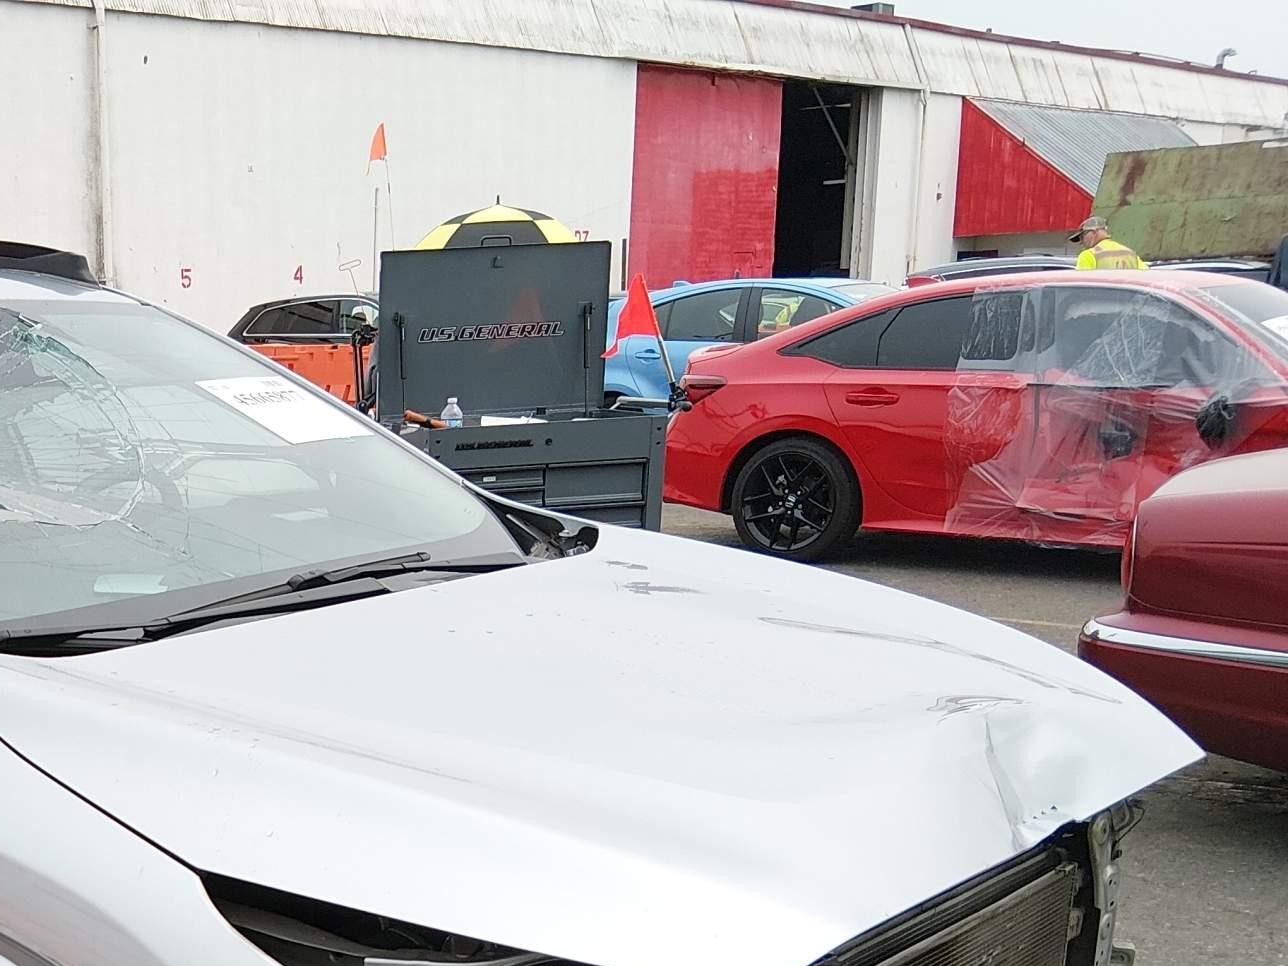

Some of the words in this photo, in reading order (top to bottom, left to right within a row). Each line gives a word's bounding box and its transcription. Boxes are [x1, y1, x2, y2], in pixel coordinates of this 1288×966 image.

[180, 268, 192, 289] 5
[293, 265, 304, 285] 4
[458, 321, 564, 341] GENERAL
